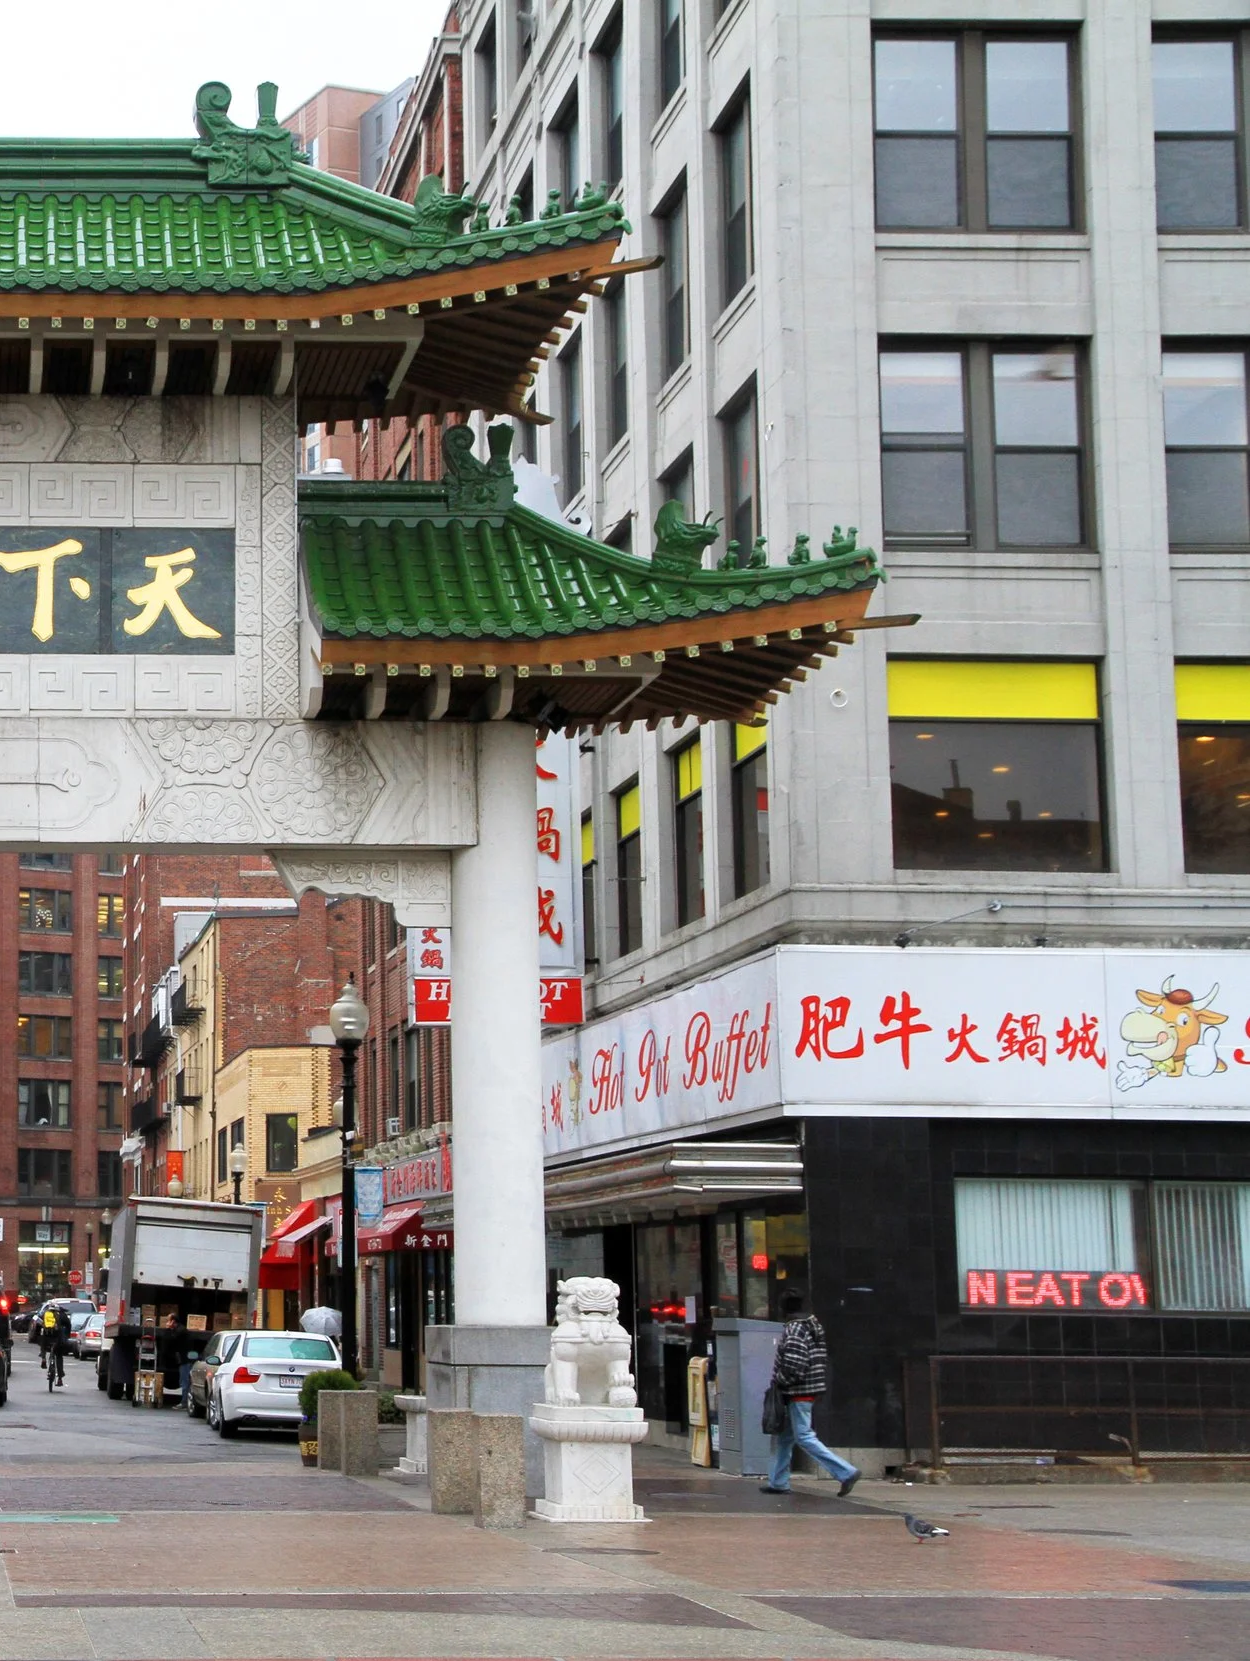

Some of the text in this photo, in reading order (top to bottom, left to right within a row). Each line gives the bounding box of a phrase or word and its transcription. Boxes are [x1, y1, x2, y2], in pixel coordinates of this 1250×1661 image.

[589, 1002, 772, 1115] Hot Pot Buffet
[1006, 1272, 1091, 1307] EAT
